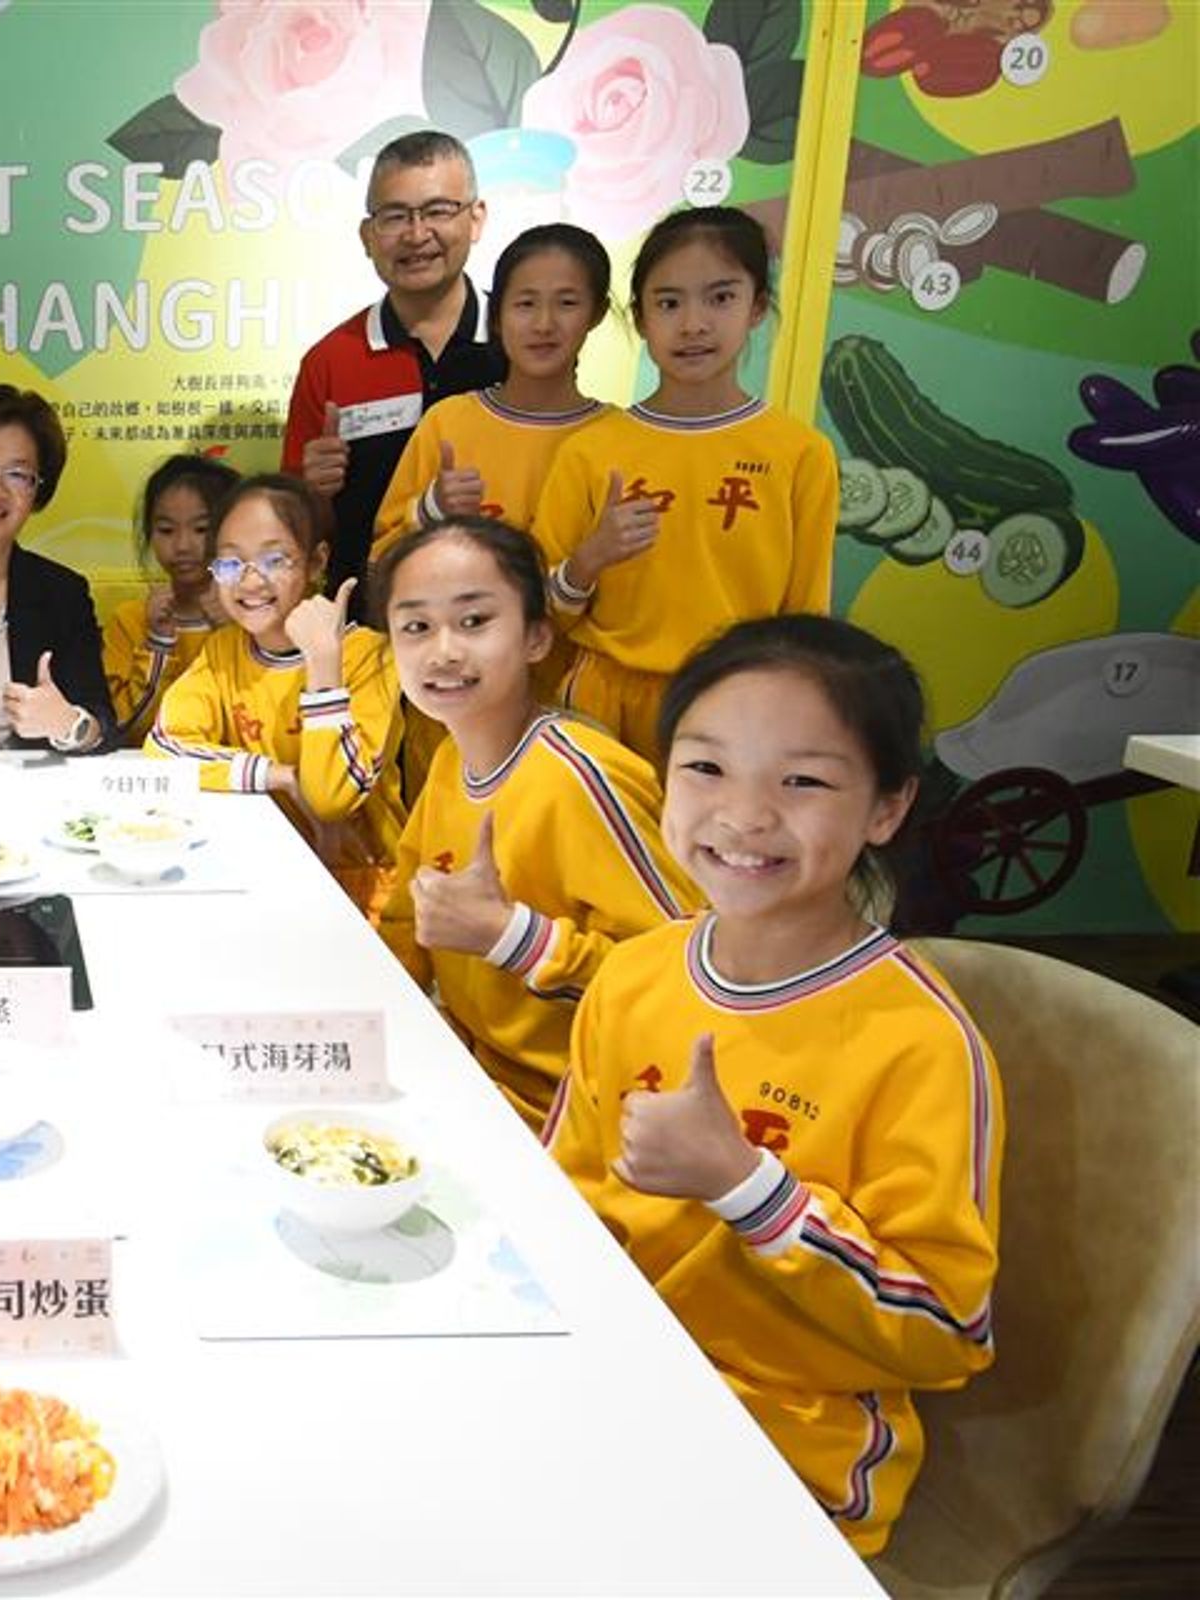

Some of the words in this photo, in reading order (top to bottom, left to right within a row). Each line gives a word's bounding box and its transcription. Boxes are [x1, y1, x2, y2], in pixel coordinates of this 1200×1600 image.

[1010, 47, 1043, 69] 20
[691, 172, 723, 193] 22
[62, 157, 372, 234] SEASO
[920, 274, 952, 298] 43
[952, 542, 981, 561] 44
[1112, 662, 1138, 682] 17
